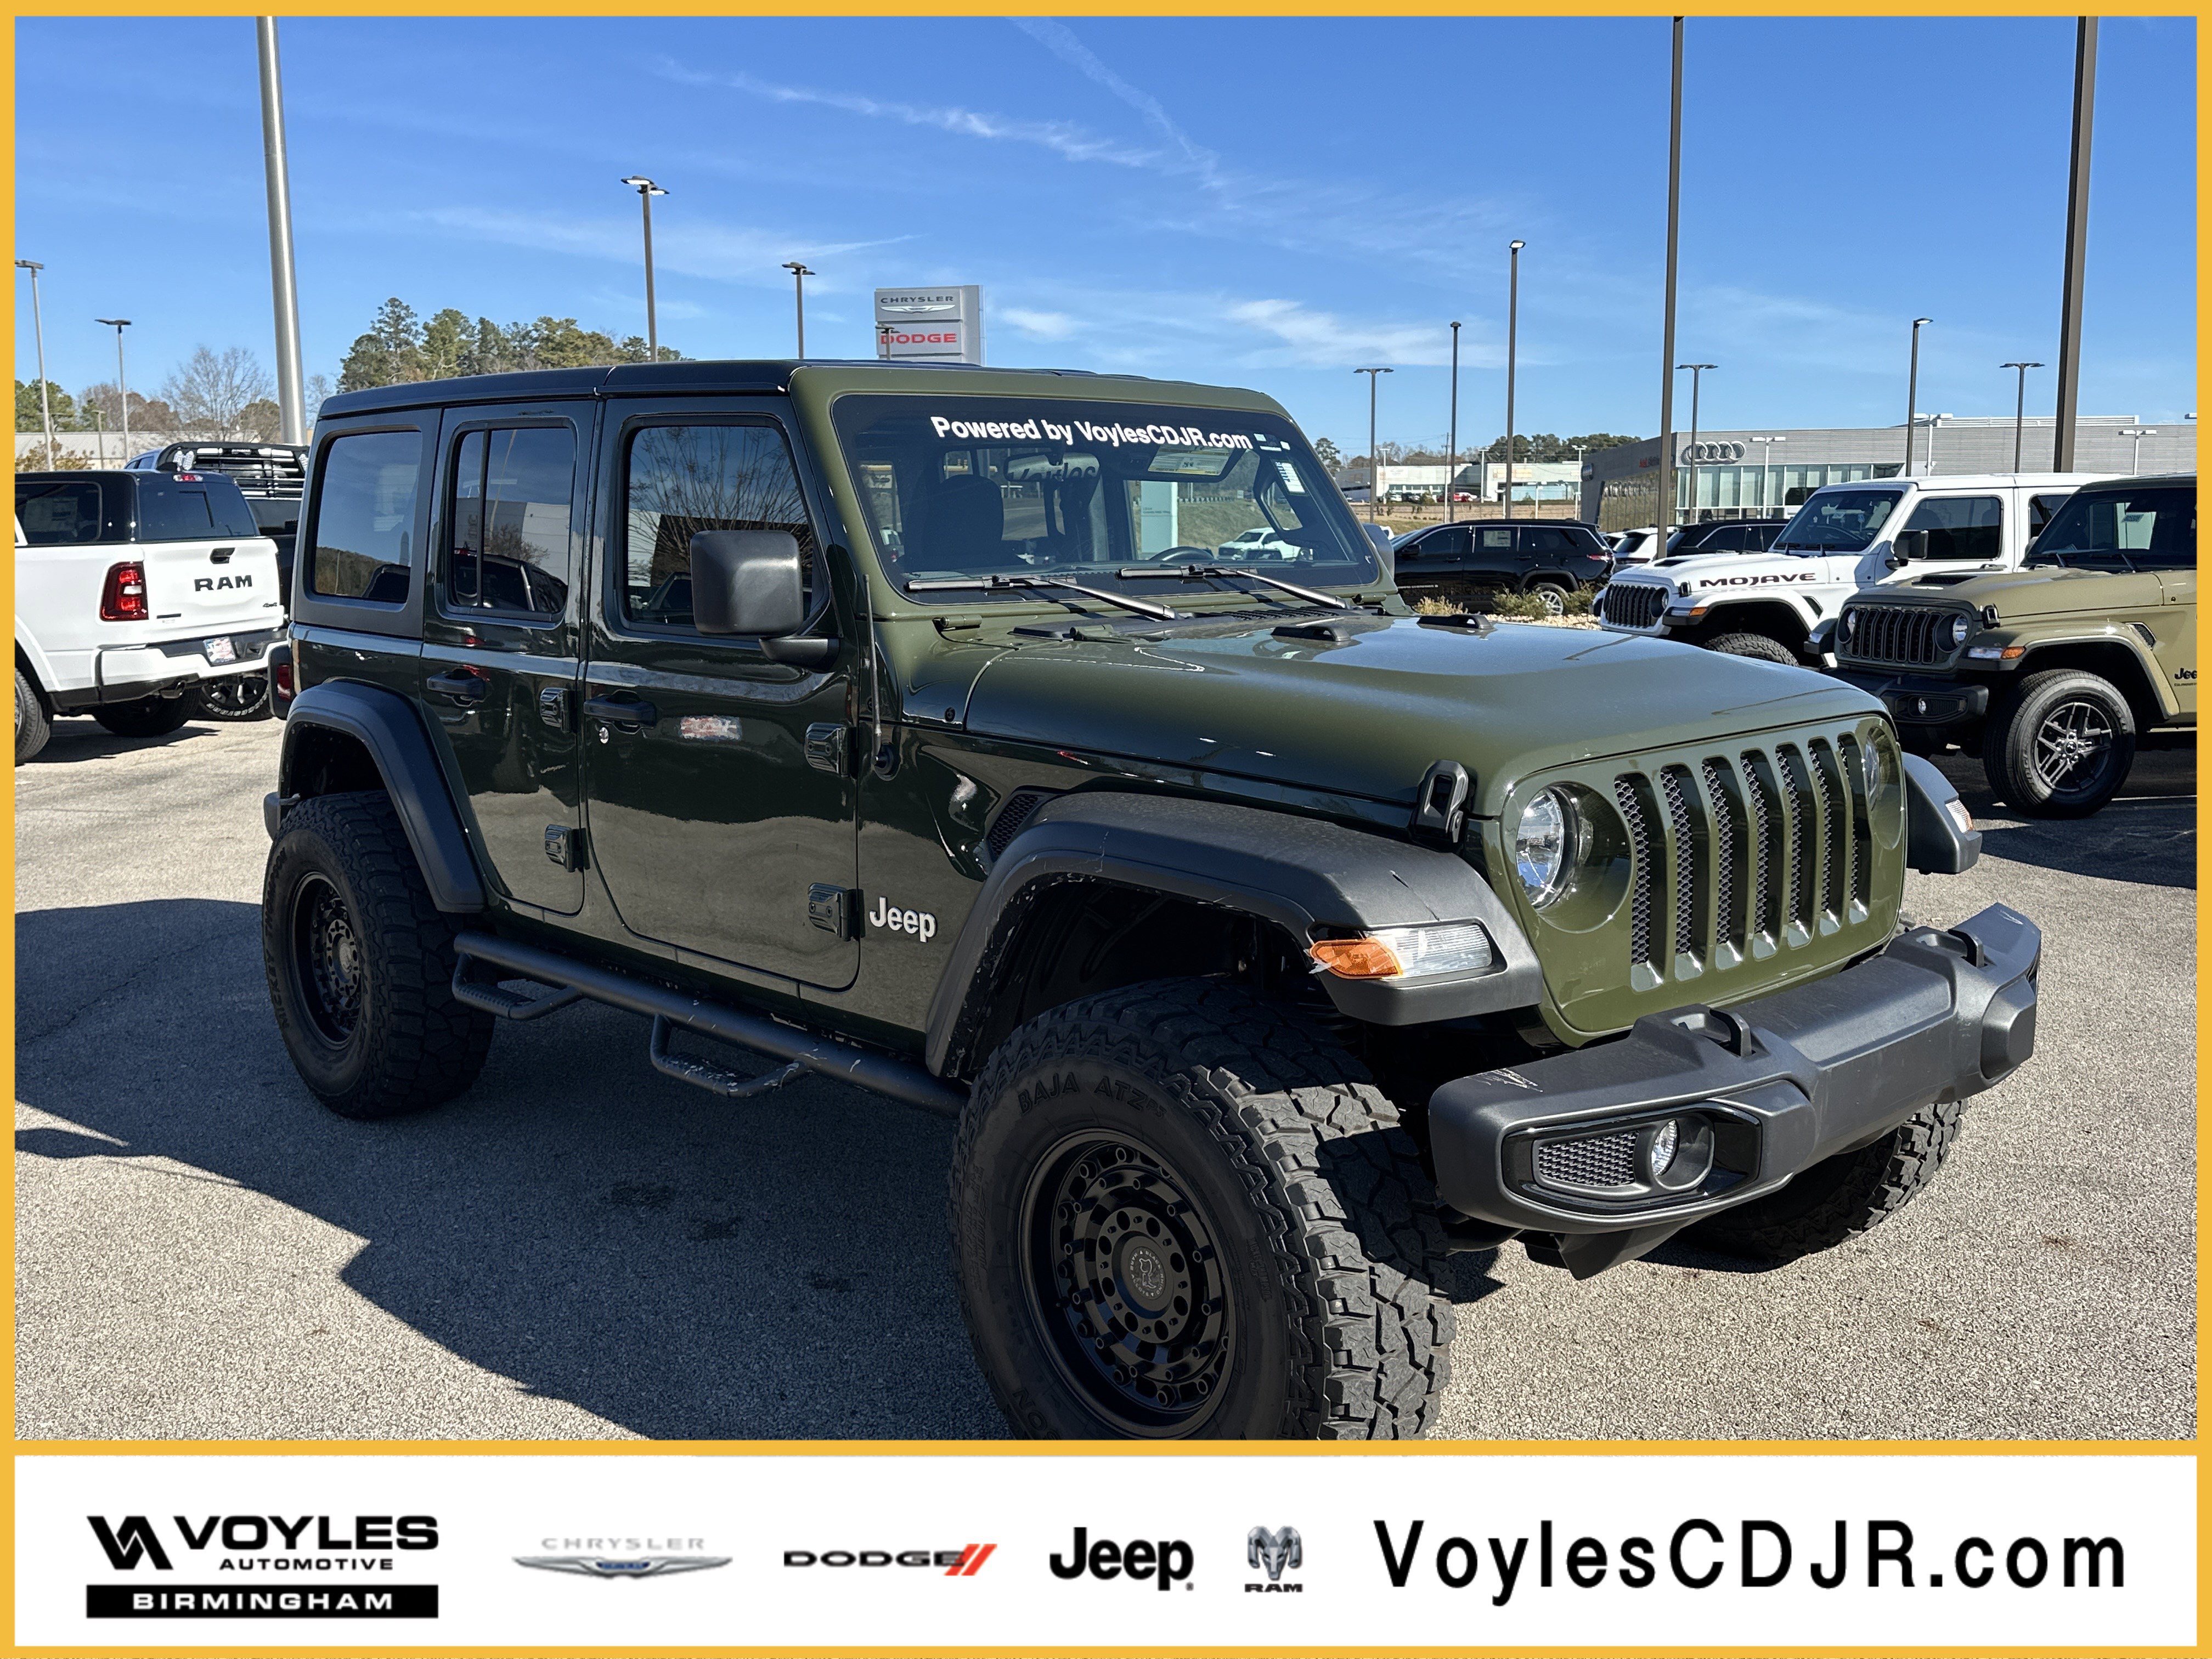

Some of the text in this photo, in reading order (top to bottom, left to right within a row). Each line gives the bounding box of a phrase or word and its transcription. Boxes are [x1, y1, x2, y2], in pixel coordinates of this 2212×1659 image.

[881, 334, 957, 345] DODGE
[930, 416, 1252, 451] Powered by VoylesCDJR.com
[194, 575, 252, 591] RAM
[1700, 573, 1816, 587] MOJAVE
[869, 896, 937, 943] Jeep
[1018, 1072, 1080, 1115] BAJA
